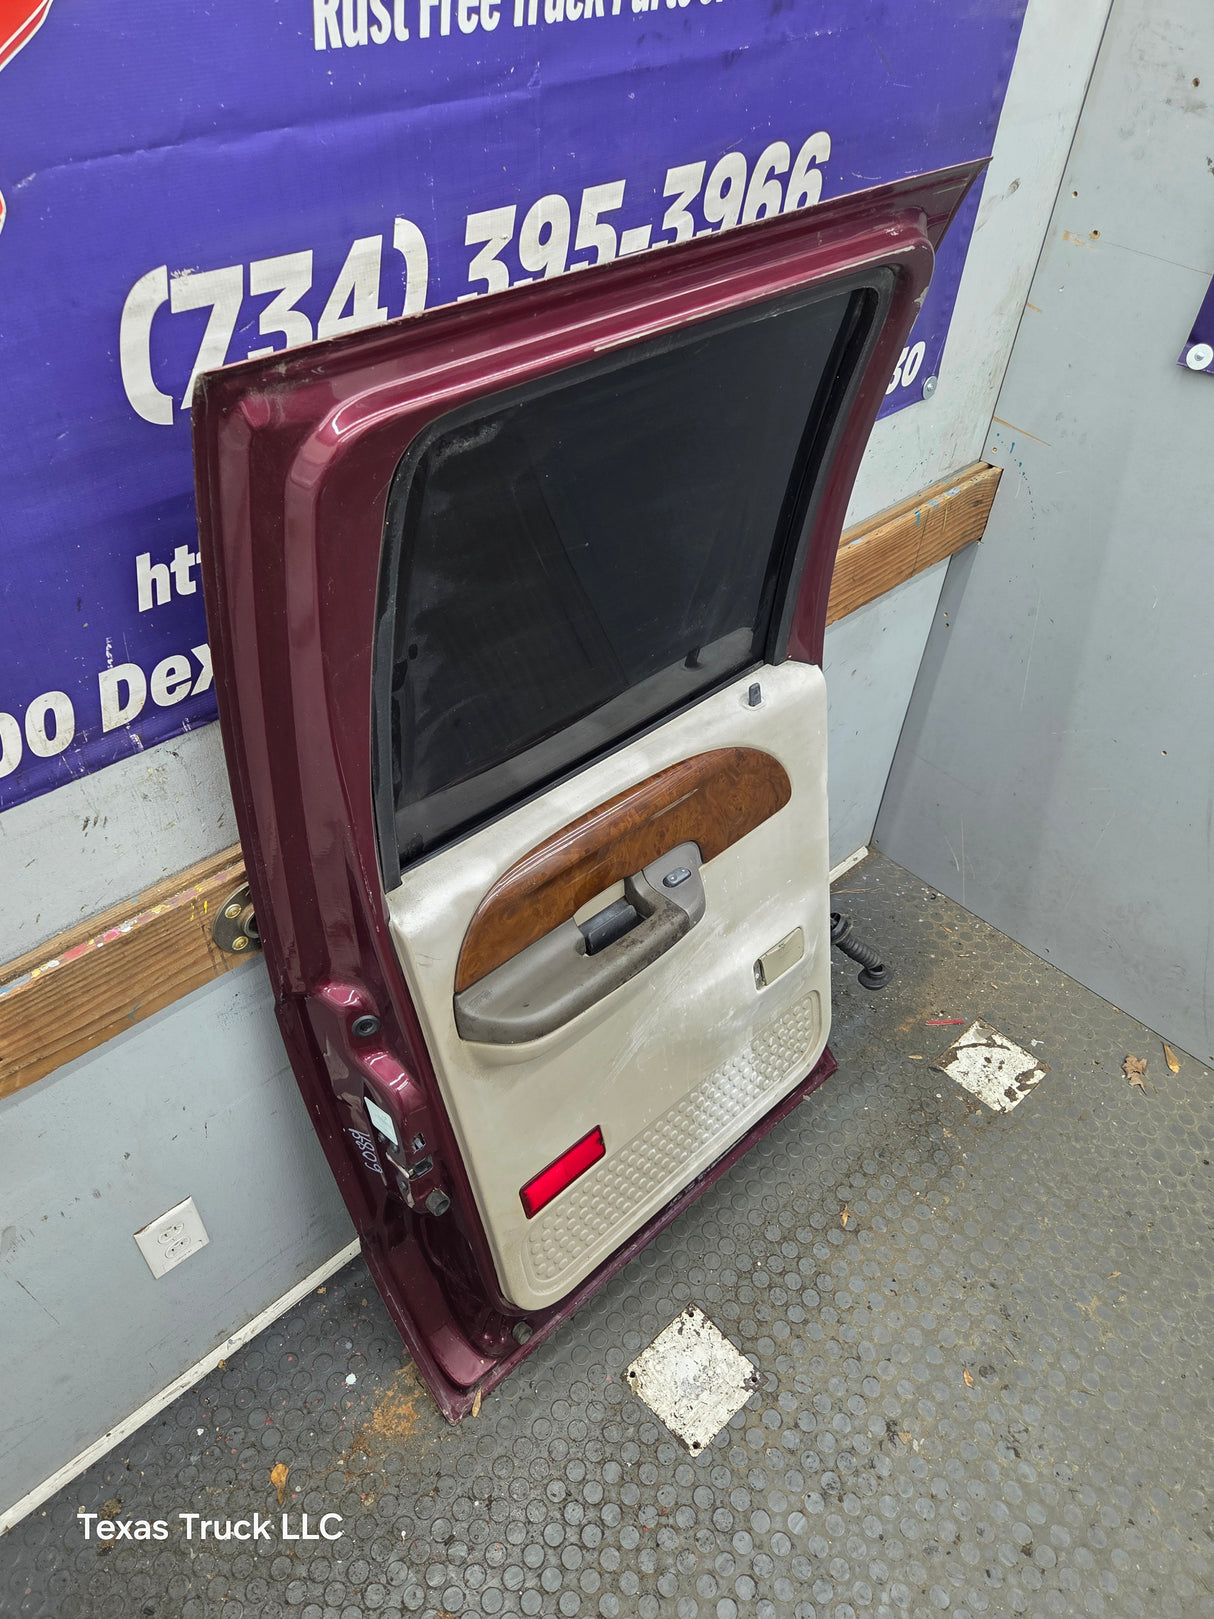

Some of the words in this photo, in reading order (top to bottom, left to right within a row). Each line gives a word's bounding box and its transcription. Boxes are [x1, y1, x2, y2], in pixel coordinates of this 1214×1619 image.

[120, 217, 428, 425] (734)
[457, 131, 831, 302] 395-3966
[136, 545, 201, 612] ht
